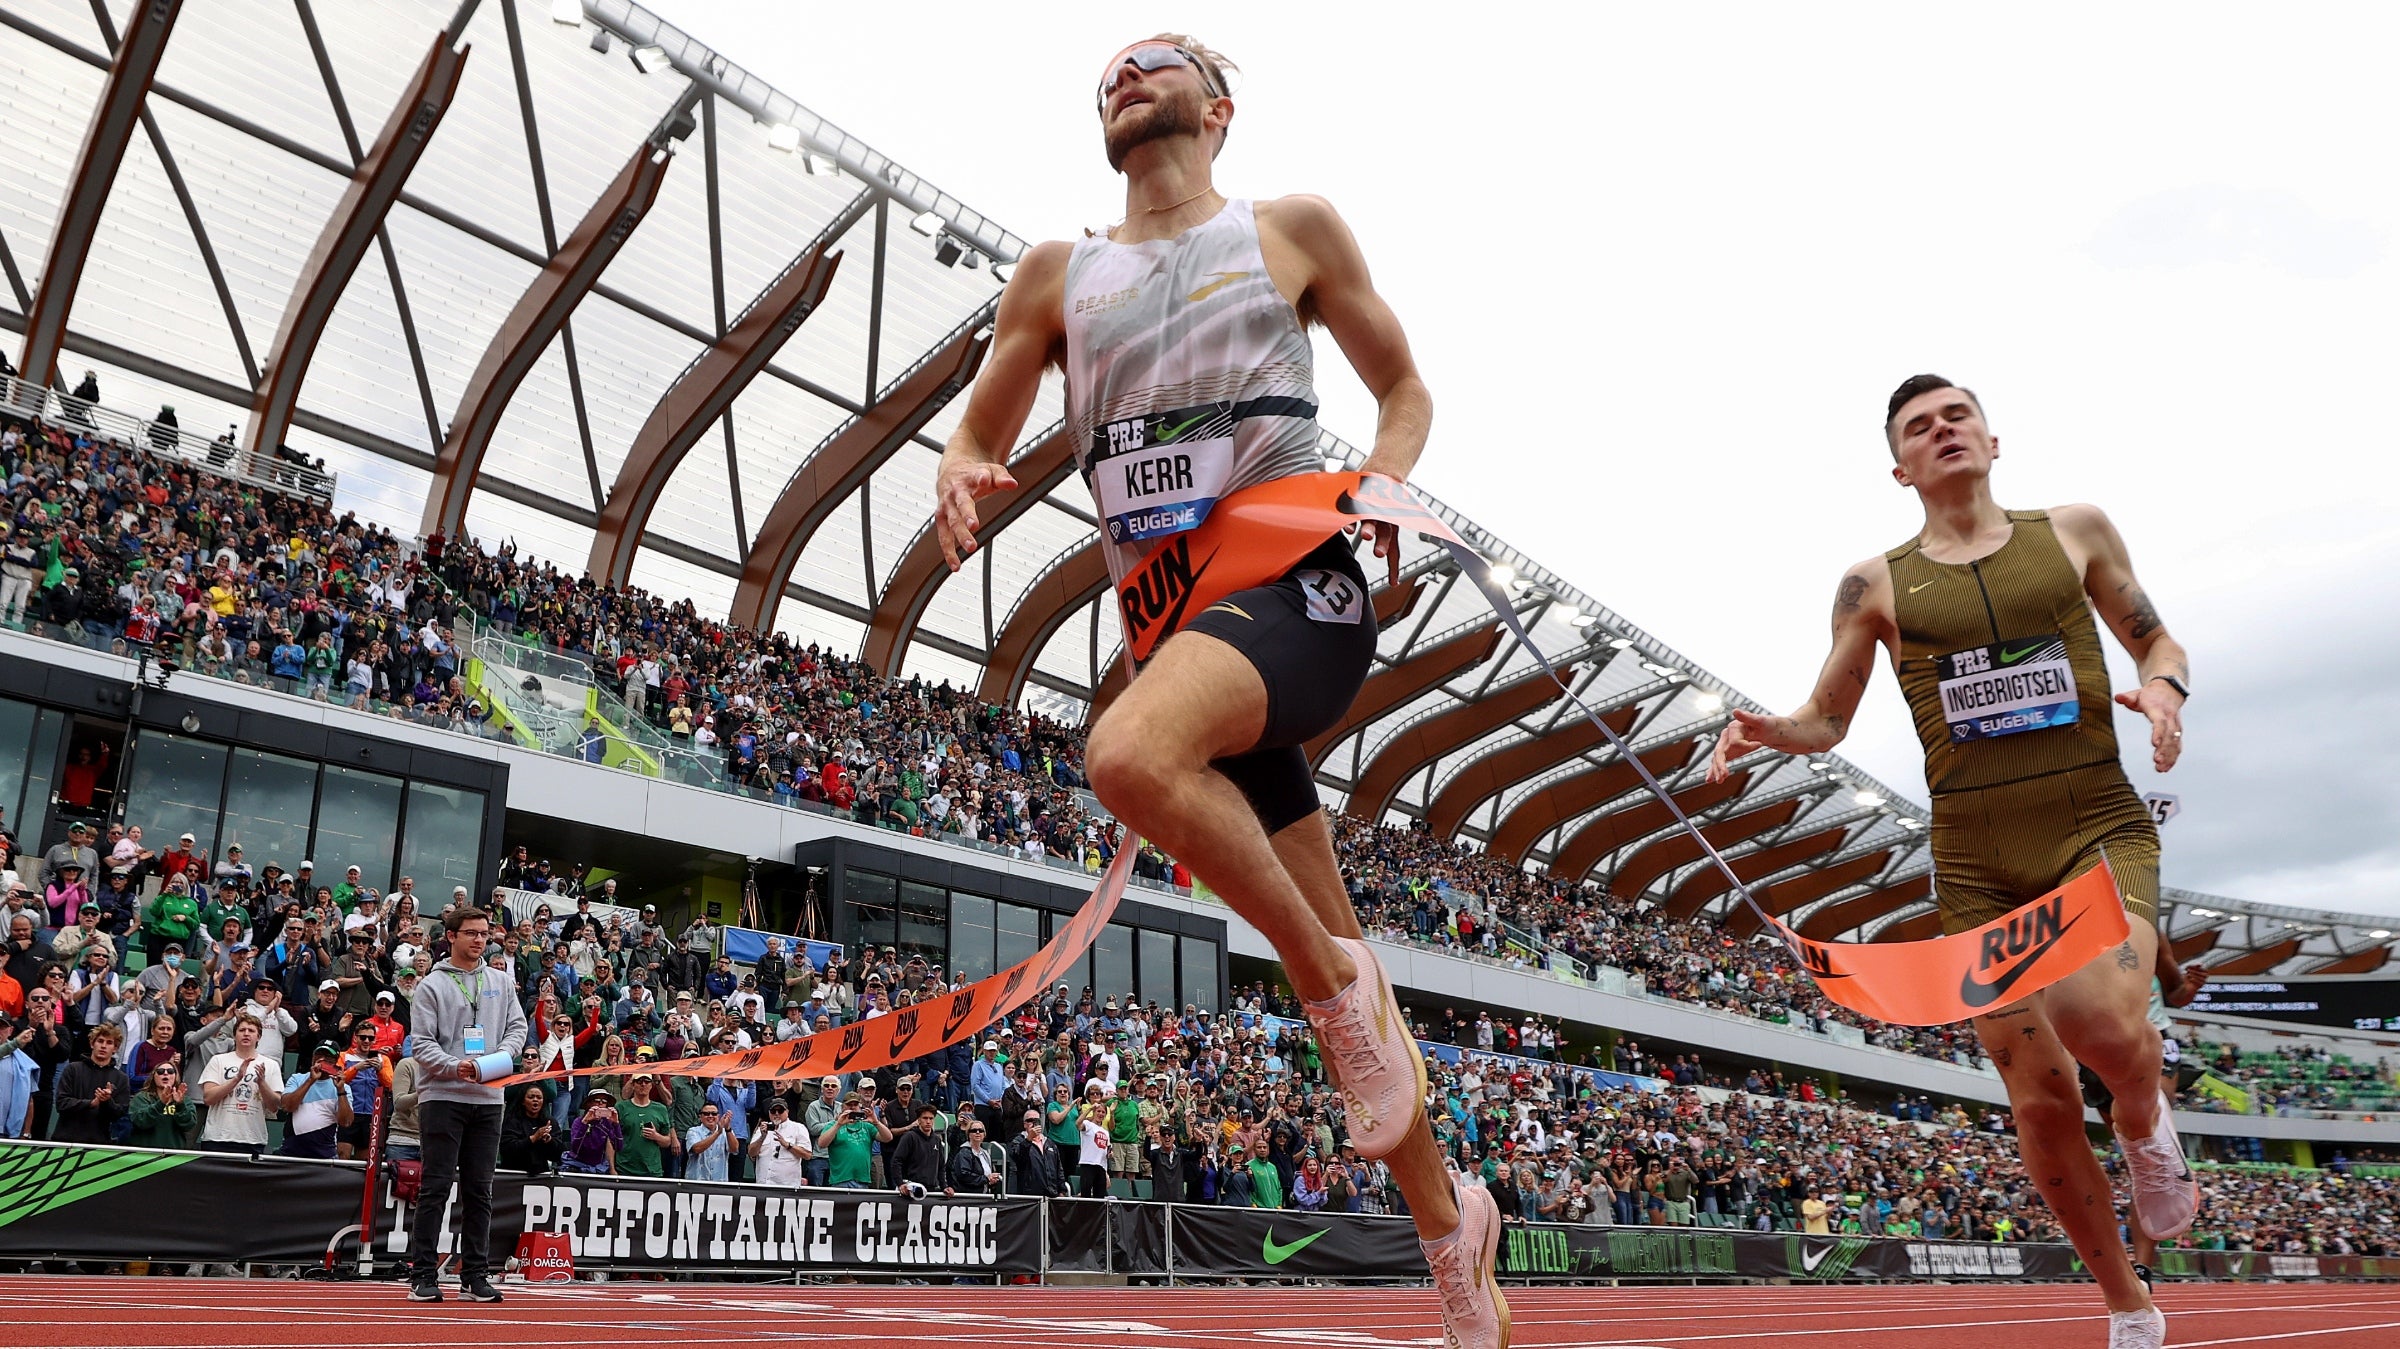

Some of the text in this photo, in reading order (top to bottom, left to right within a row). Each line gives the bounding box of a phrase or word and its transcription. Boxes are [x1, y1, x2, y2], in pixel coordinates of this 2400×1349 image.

[1075, 288, 1139, 314] BEASTS
[1107, 420, 1145, 455] PRE
[1125, 455, 1194, 498] KERR
[1360, 476, 1419, 506] RU
[1128, 507, 1195, 534] EUGENE
[1120, 534, 1196, 643] RUN
[1308, 570, 1354, 616] 13
[1951, 647, 1991, 677] PRE
[1946, 667, 2068, 713] INGEBRIGTSEN
[1980, 710, 2046, 733] EUGENE
[2149, 799, 2172, 825] 15
[1980, 895, 2066, 970] RUN
[950, 989, 976, 1020] RUN
[841, 1025, 865, 1051] RUN
[895, 1009, 919, 1037] RUN
[736, 1050, 763, 1068] RUN
[788, 1039, 813, 1062] RUN
[1340, 1081, 1381, 1133] OOKS
[368, 1115, 379, 1169] OMEGA
[522, 1185, 835, 1261] PREFONTAINE
[855, 1201, 998, 1265] CLASSIC
[520, 1258, 531, 1267] EGA
[533, 1258, 571, 1268] OMEGA
[1530, 1230, 1569, 1272] FIELD
